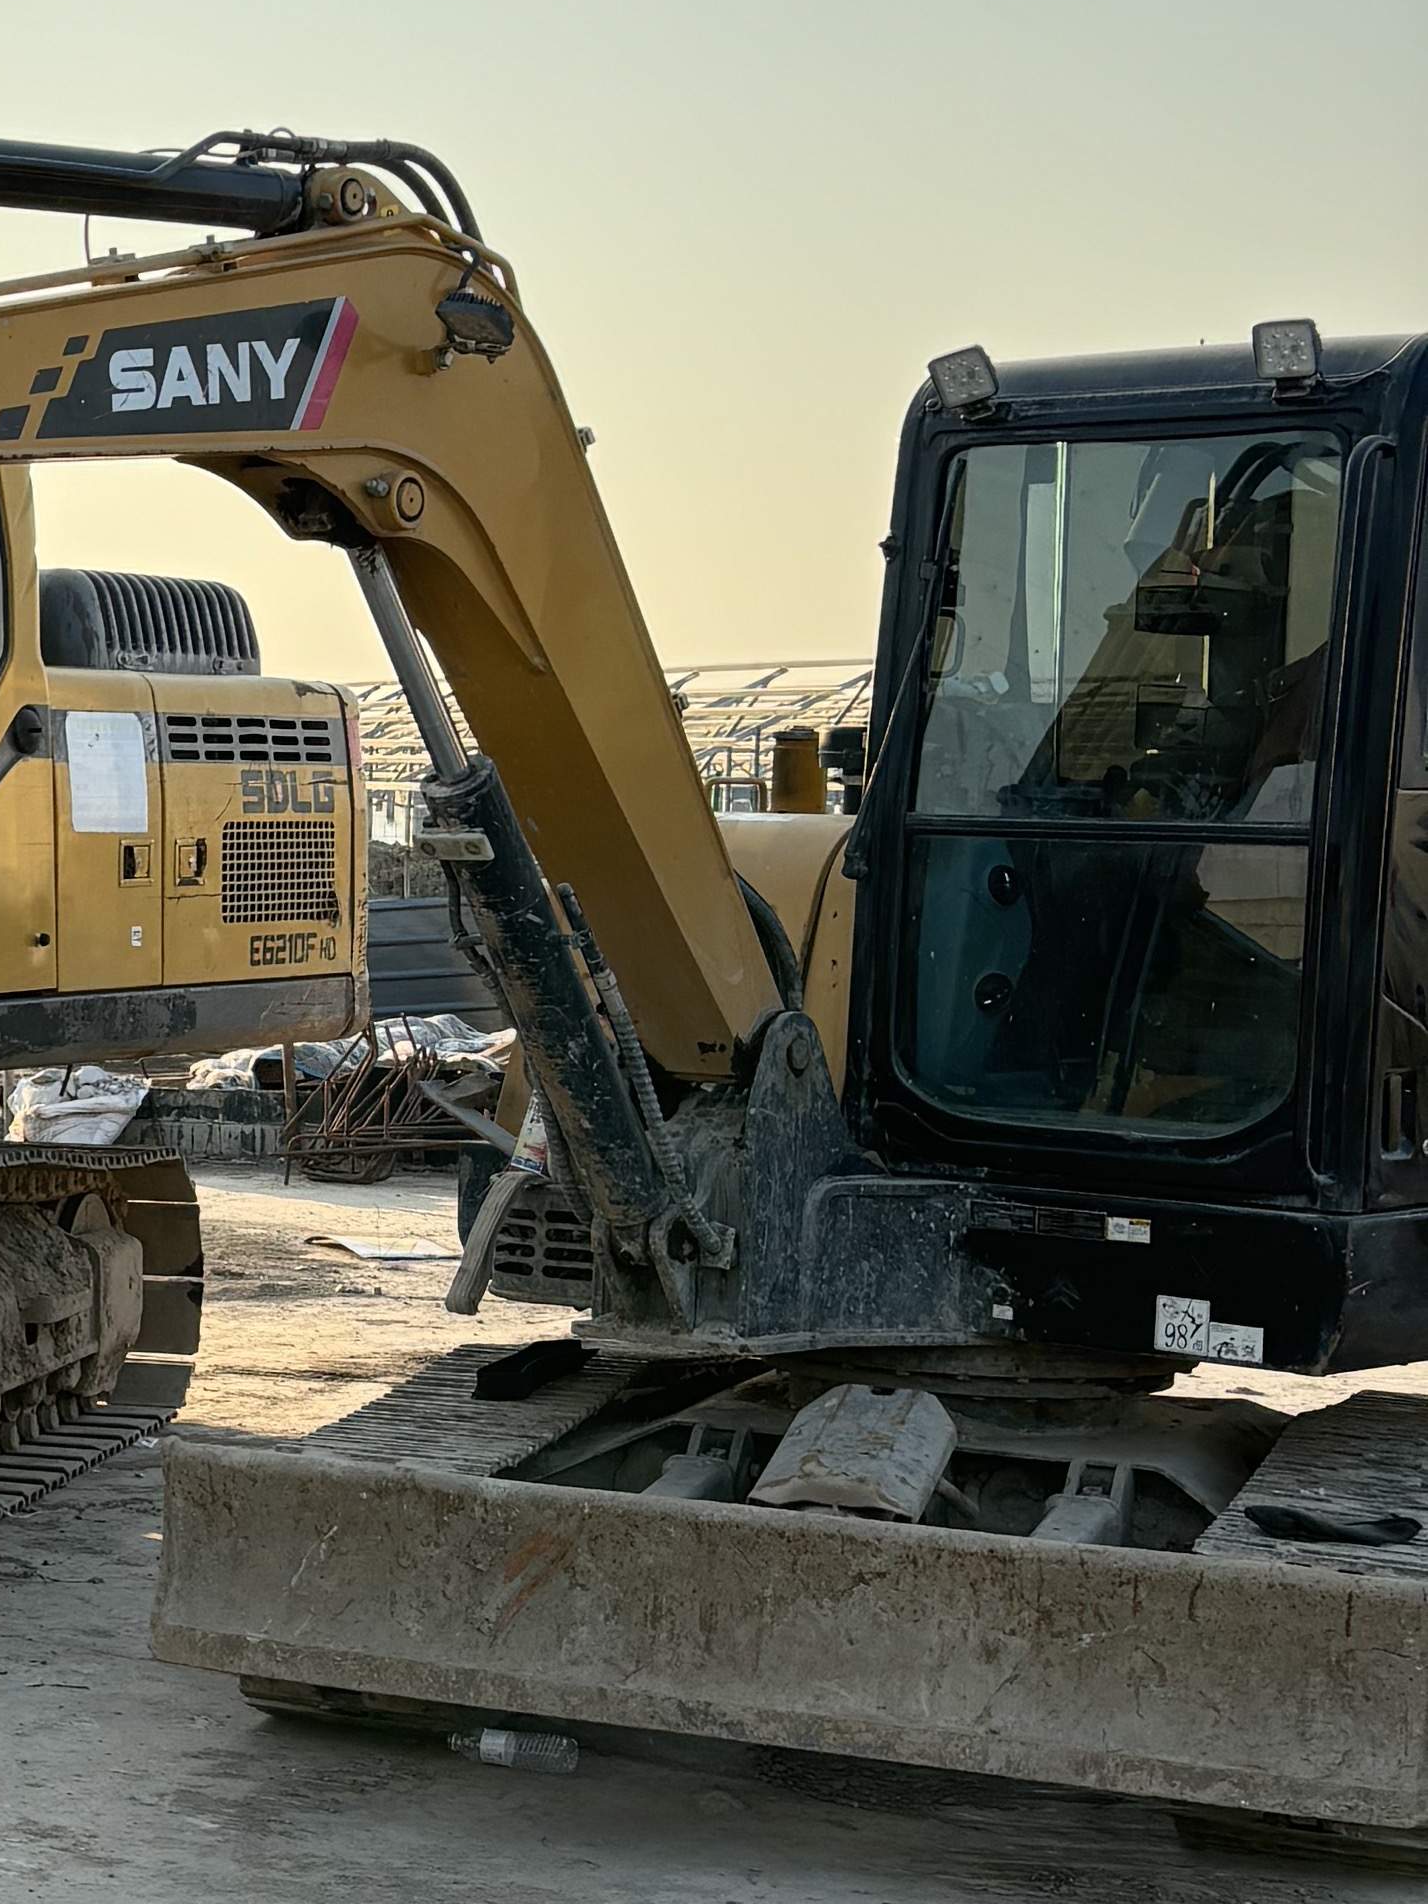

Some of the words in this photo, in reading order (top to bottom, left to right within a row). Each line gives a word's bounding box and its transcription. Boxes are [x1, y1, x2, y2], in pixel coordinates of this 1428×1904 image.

[108, 337, 301, 413] SANY
[241, 770, 335, 813] SDLG
[1165, 1322, 1188, 1349] 98
